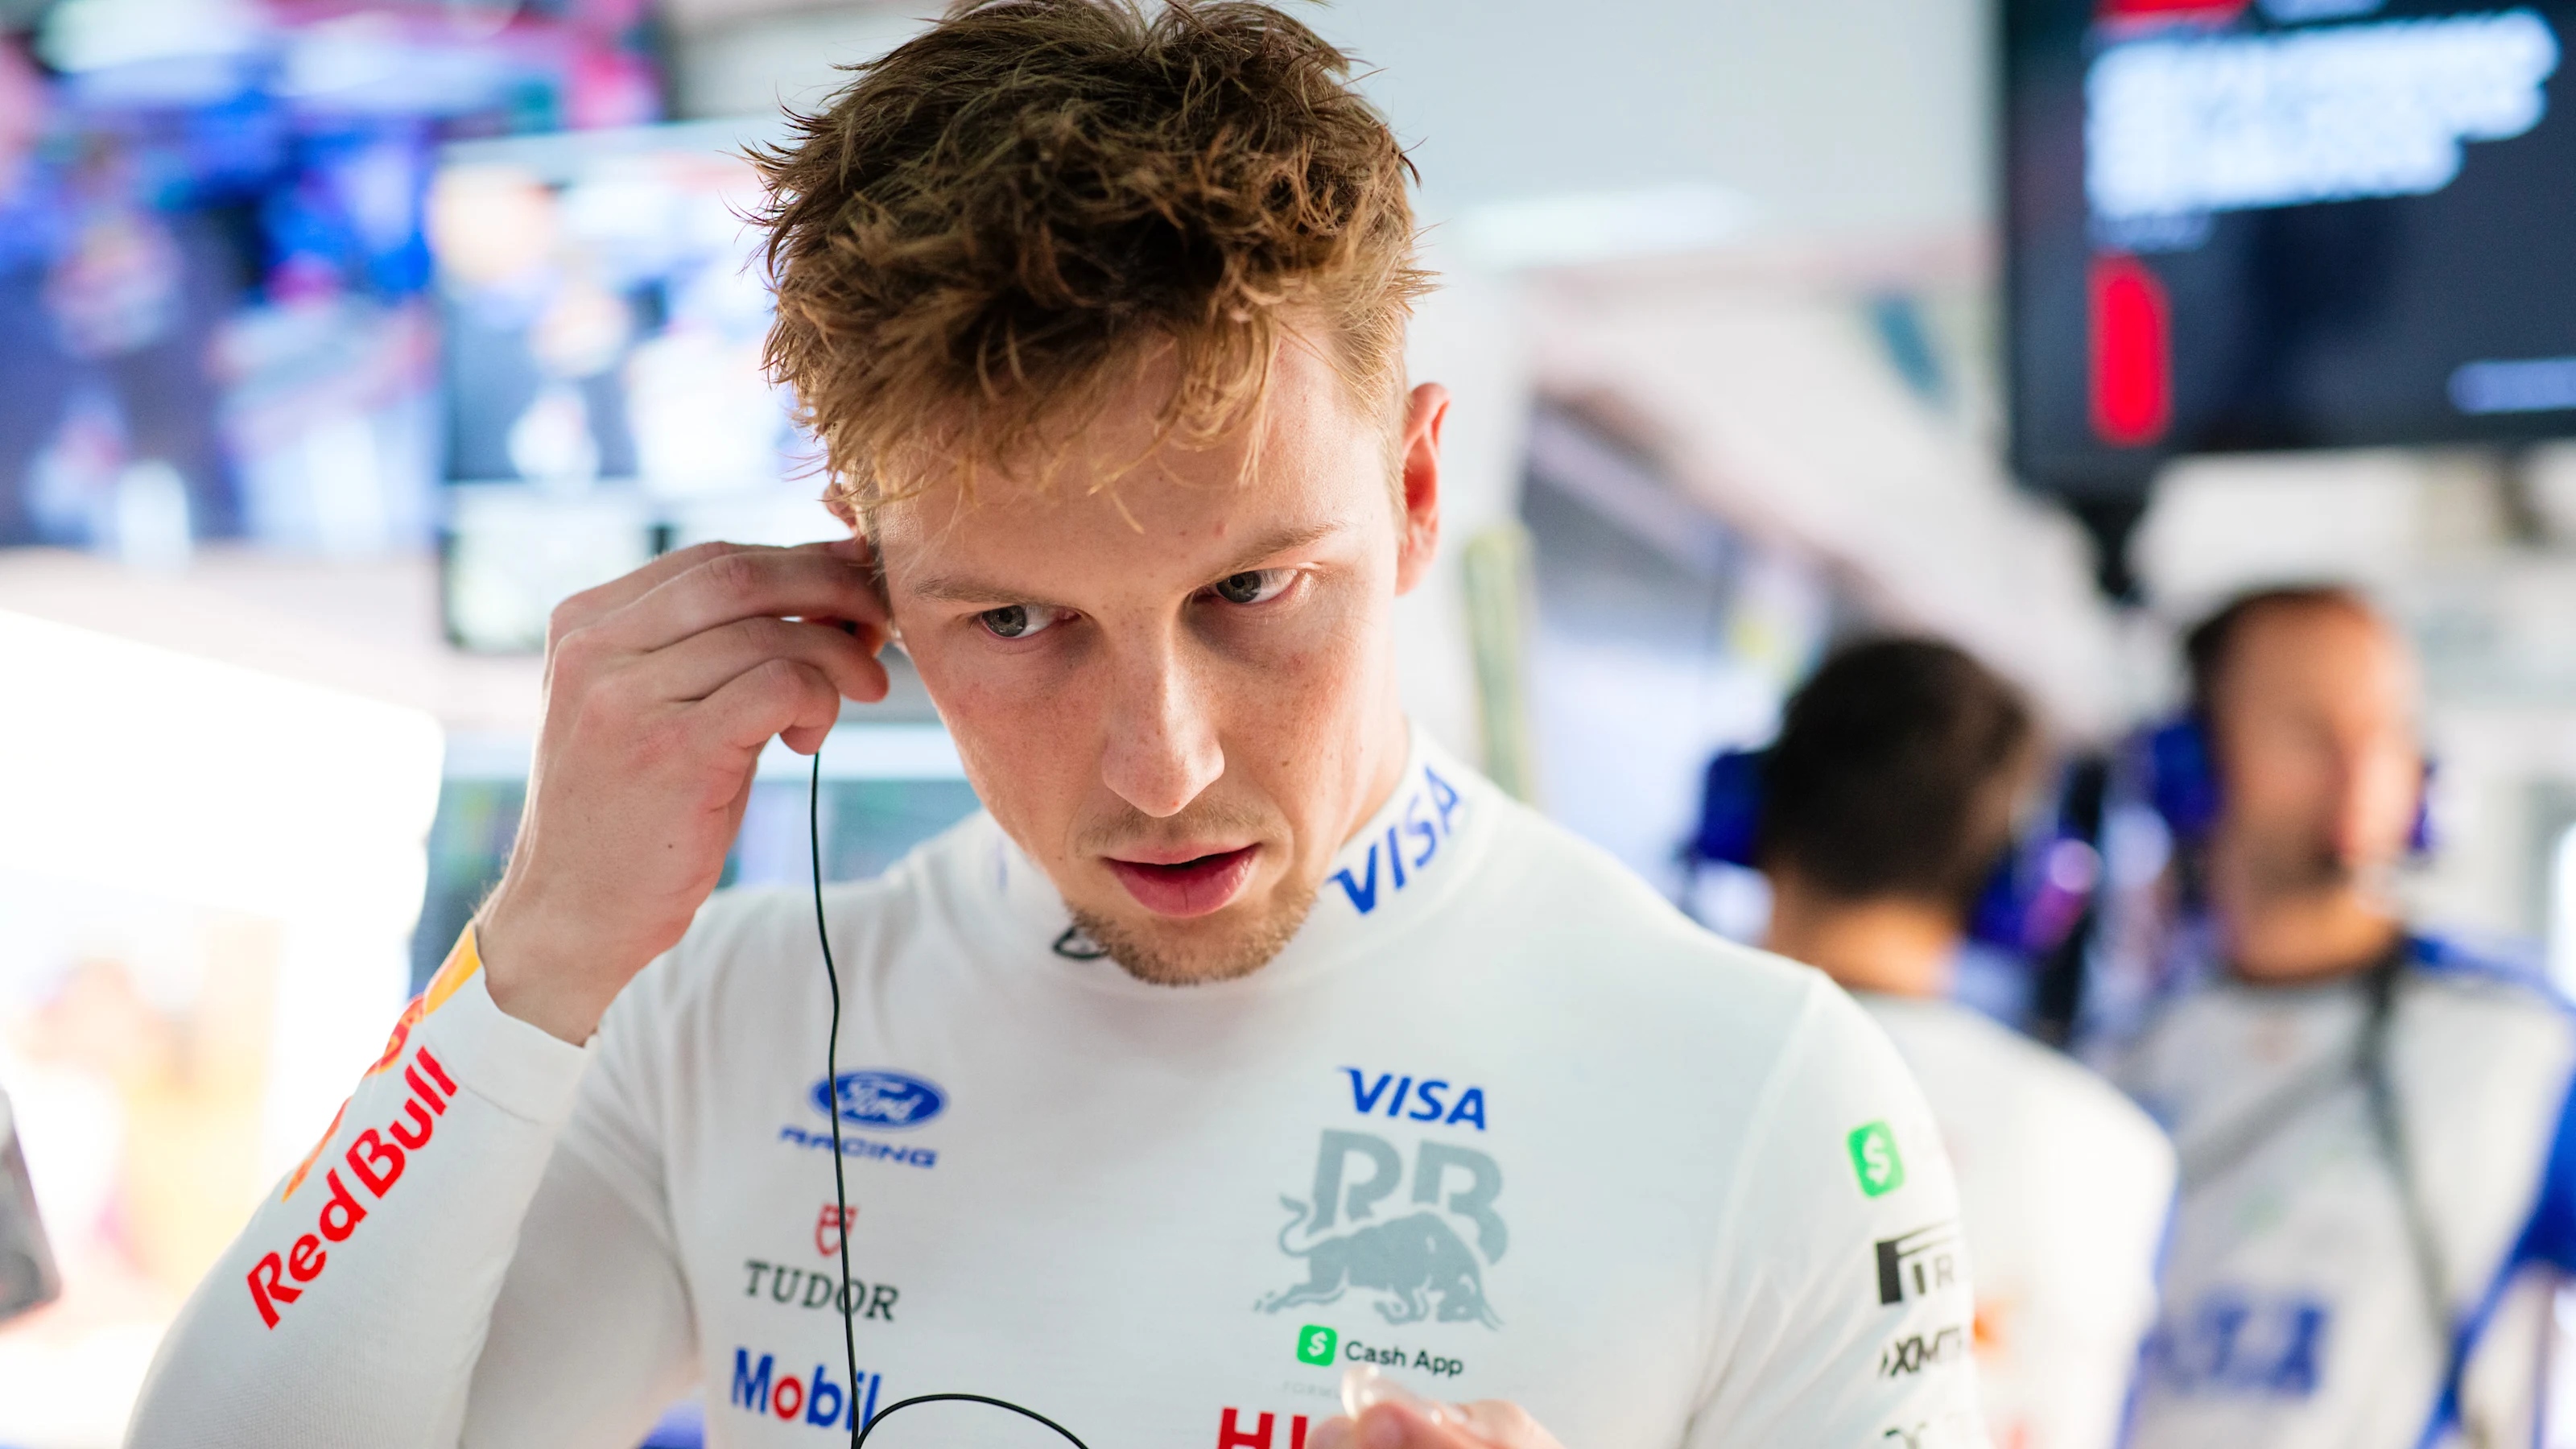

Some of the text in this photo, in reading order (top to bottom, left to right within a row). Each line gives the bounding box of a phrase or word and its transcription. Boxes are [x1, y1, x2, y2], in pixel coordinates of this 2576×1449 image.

[1327, 763, 1465, 914] VISA
[834, 1075, 924, 1121] Ford
[1336, 1067, 1487, 1130] VISA
[778, 1124, 937, 1169] RACING
[246, 1044, 458, 1331] Red Bull
[744, 1260, 900, 1321] TUDOR
[731, 1346, 883, 1433] Mobil
[1345, 1341, 1406, 1368] Cash
[1412, 1349, 1464, 1377] App
